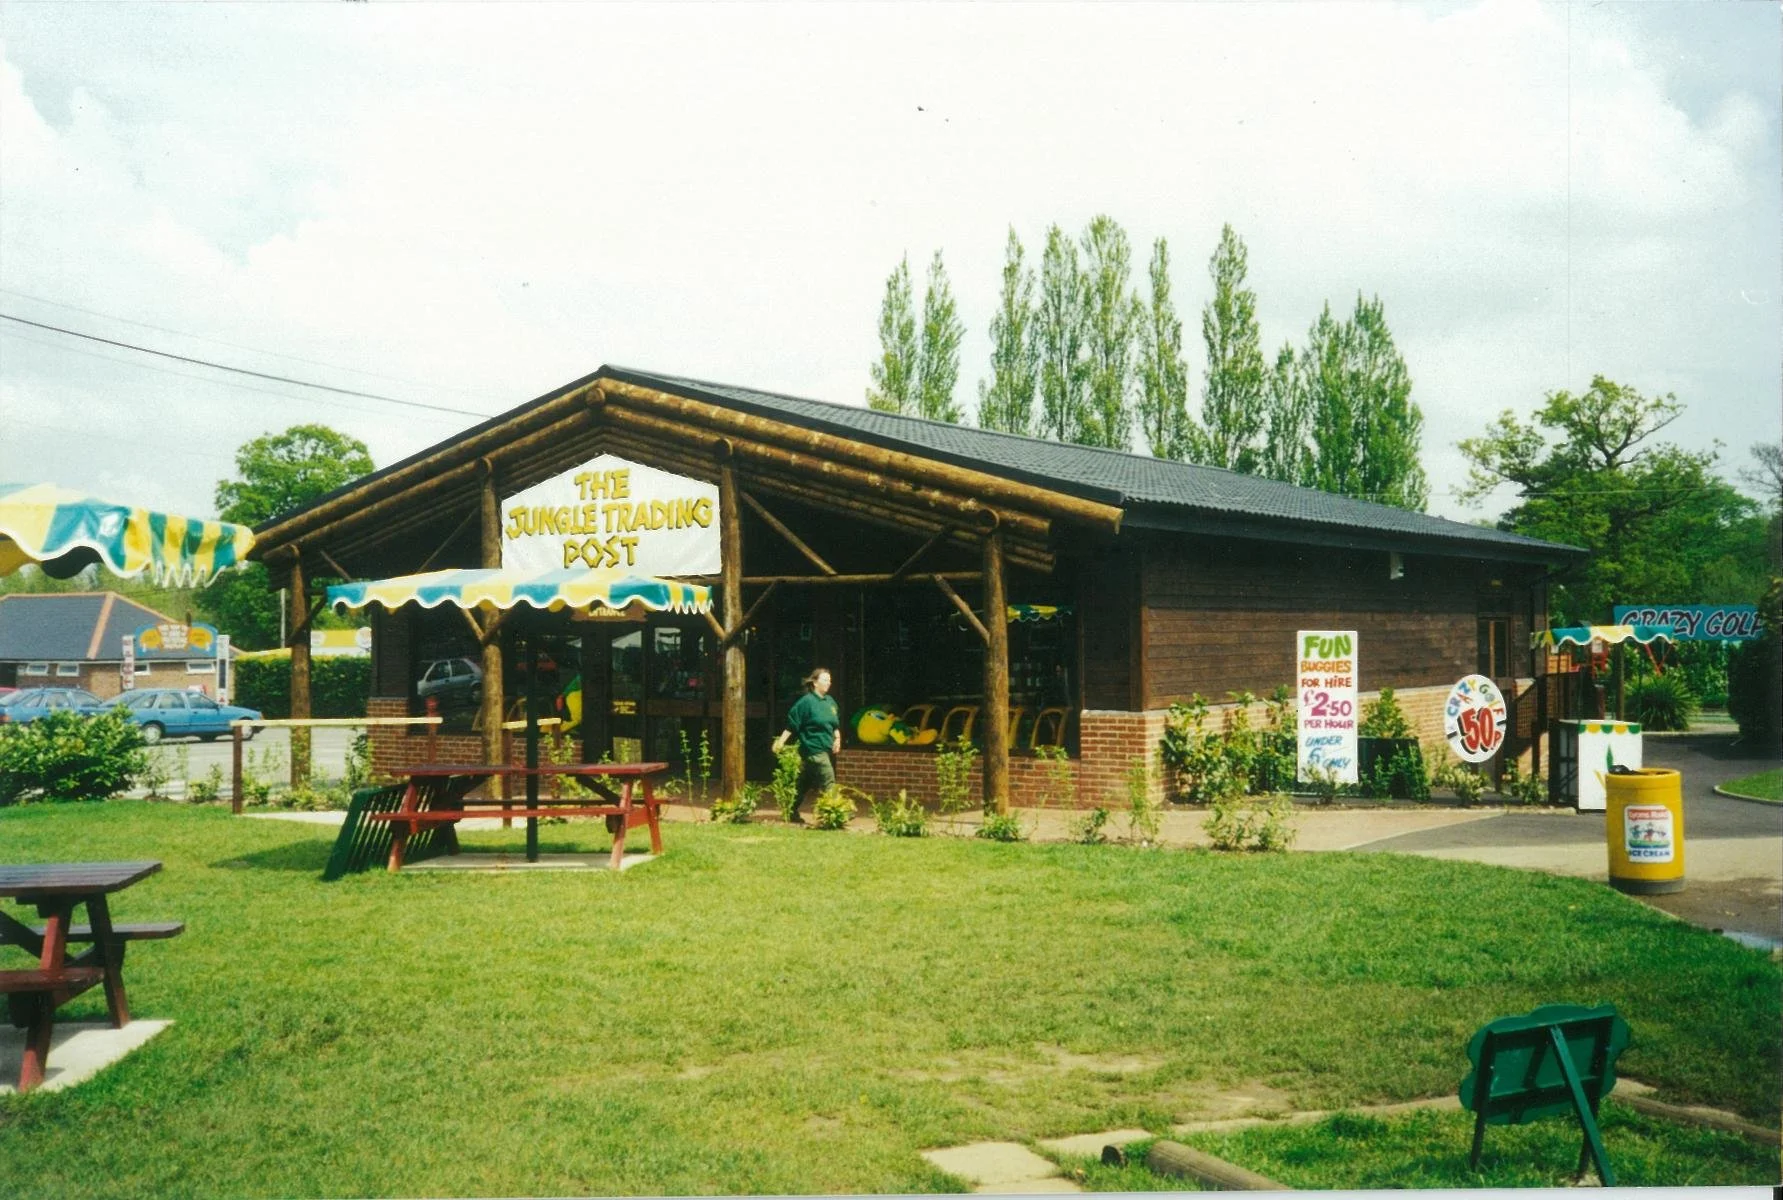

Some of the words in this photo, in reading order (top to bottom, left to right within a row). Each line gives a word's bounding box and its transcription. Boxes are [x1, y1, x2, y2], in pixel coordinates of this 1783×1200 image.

[574, 468, 631, 500] THE
[505, 506, 598, 540] JUNGLE
[602, 497, 713, 533] TRADING
[563, 536, 640, 569] POST
[1304, 633, 1352, 659] FUN
[1300, 660, 1352, 674] BUGGIES
[1301, 677, 1320, 688] FOR
[1447, 679, 1477, 716] CRAZY
[1479, 683, 1505, 715] GOLF
[1303, 719, 1322, 729] PER
[1325, 719, 1354, 729] HOUR
[1305, 735, 1343, 747] UNDER
